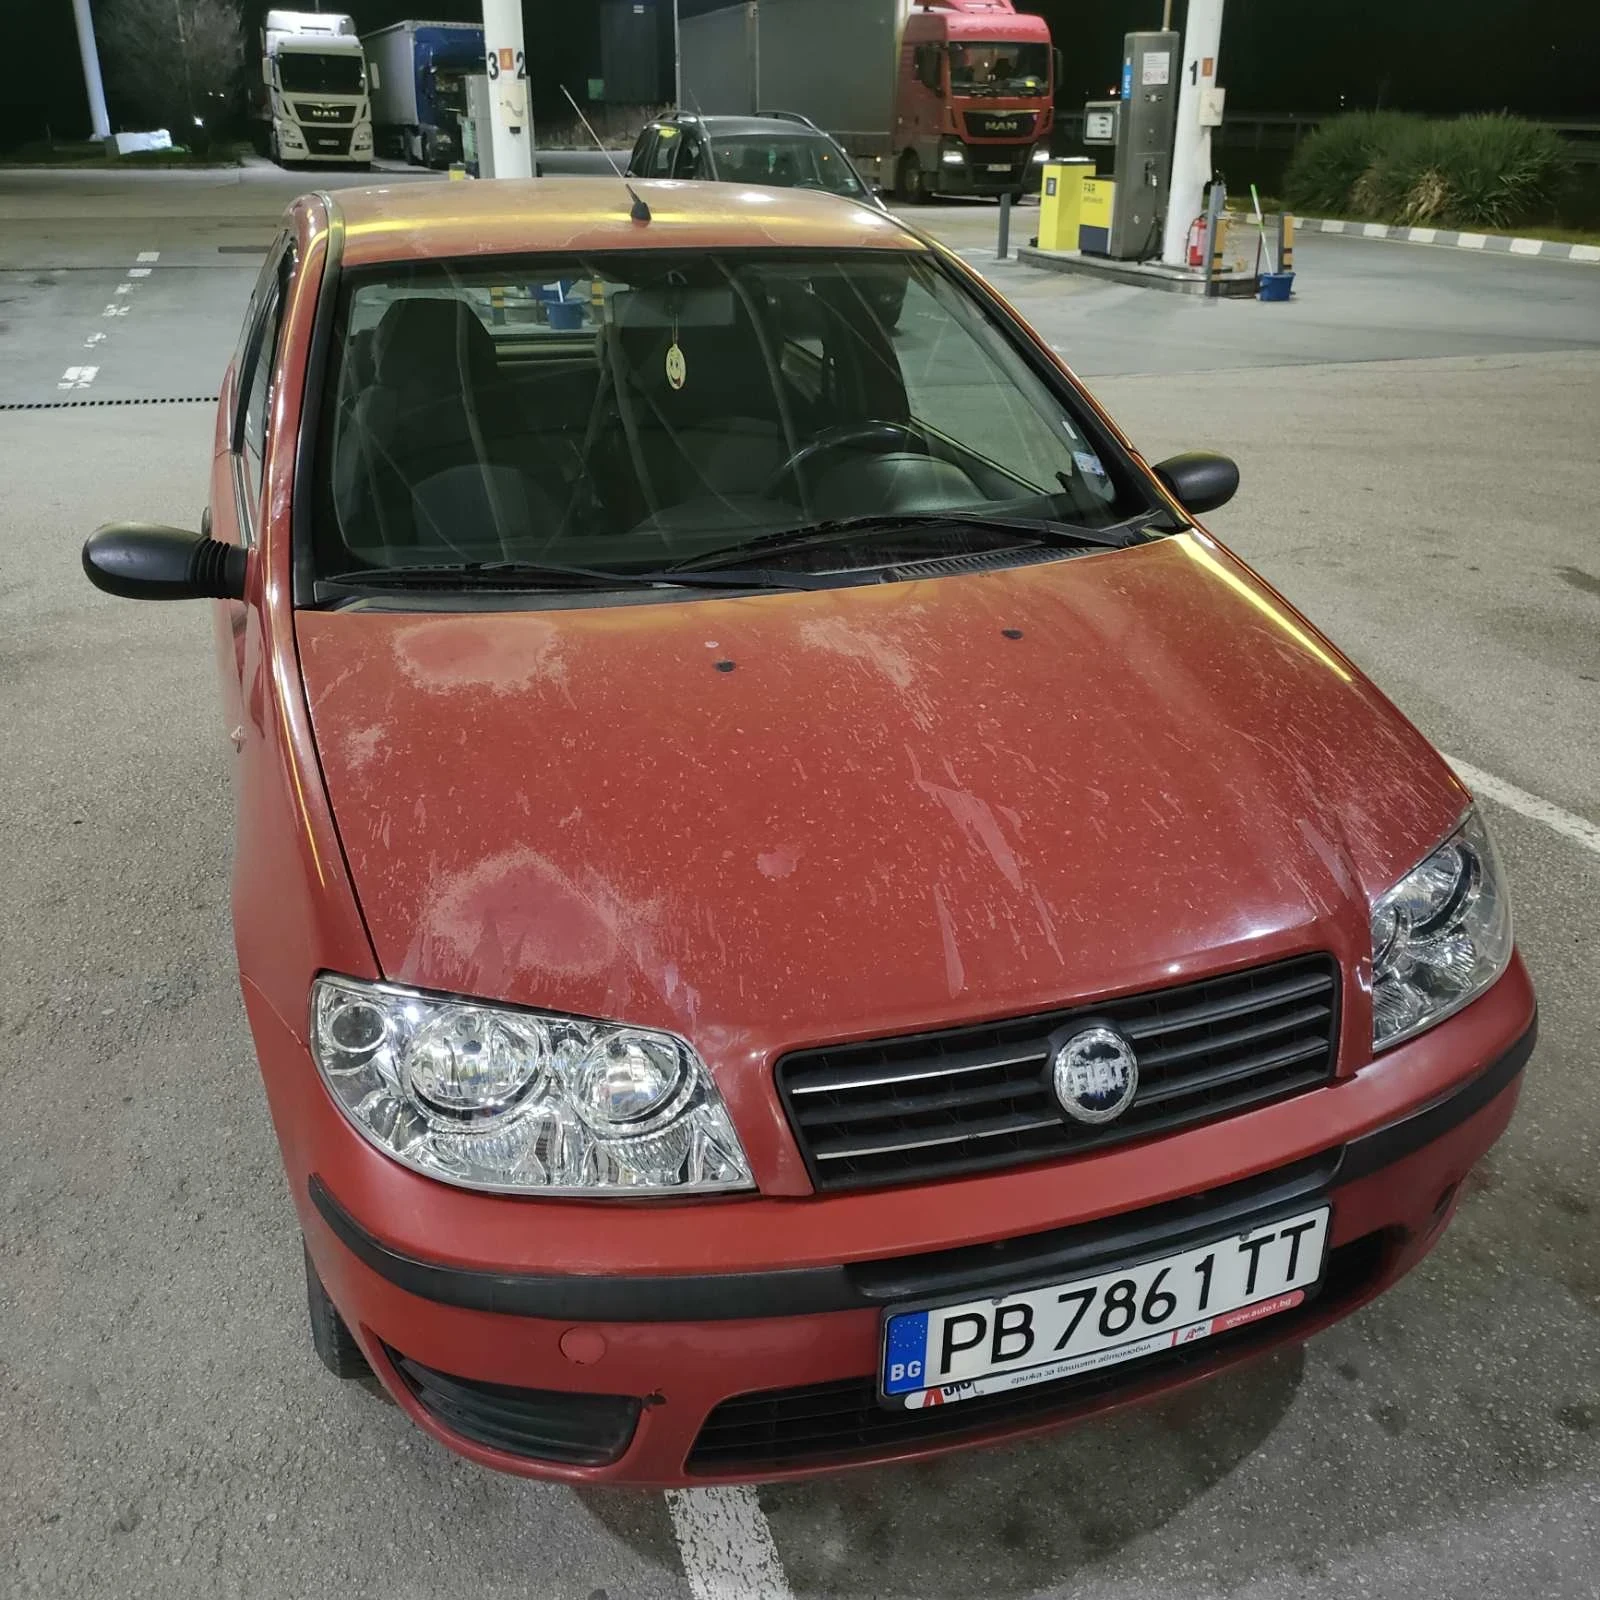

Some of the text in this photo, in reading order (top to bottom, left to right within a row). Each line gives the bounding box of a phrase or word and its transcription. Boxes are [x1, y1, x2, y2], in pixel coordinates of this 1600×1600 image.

[488, 52, 499, 80] 3
[516, 51, 526, 79] 2
[1189, 60, 1198, 86] 1
[985, 121, 1017, 130] MAN
[939, 1220, 1317, 1375] PB 7861 TT
[890, 1361, 921, 1382] BG
